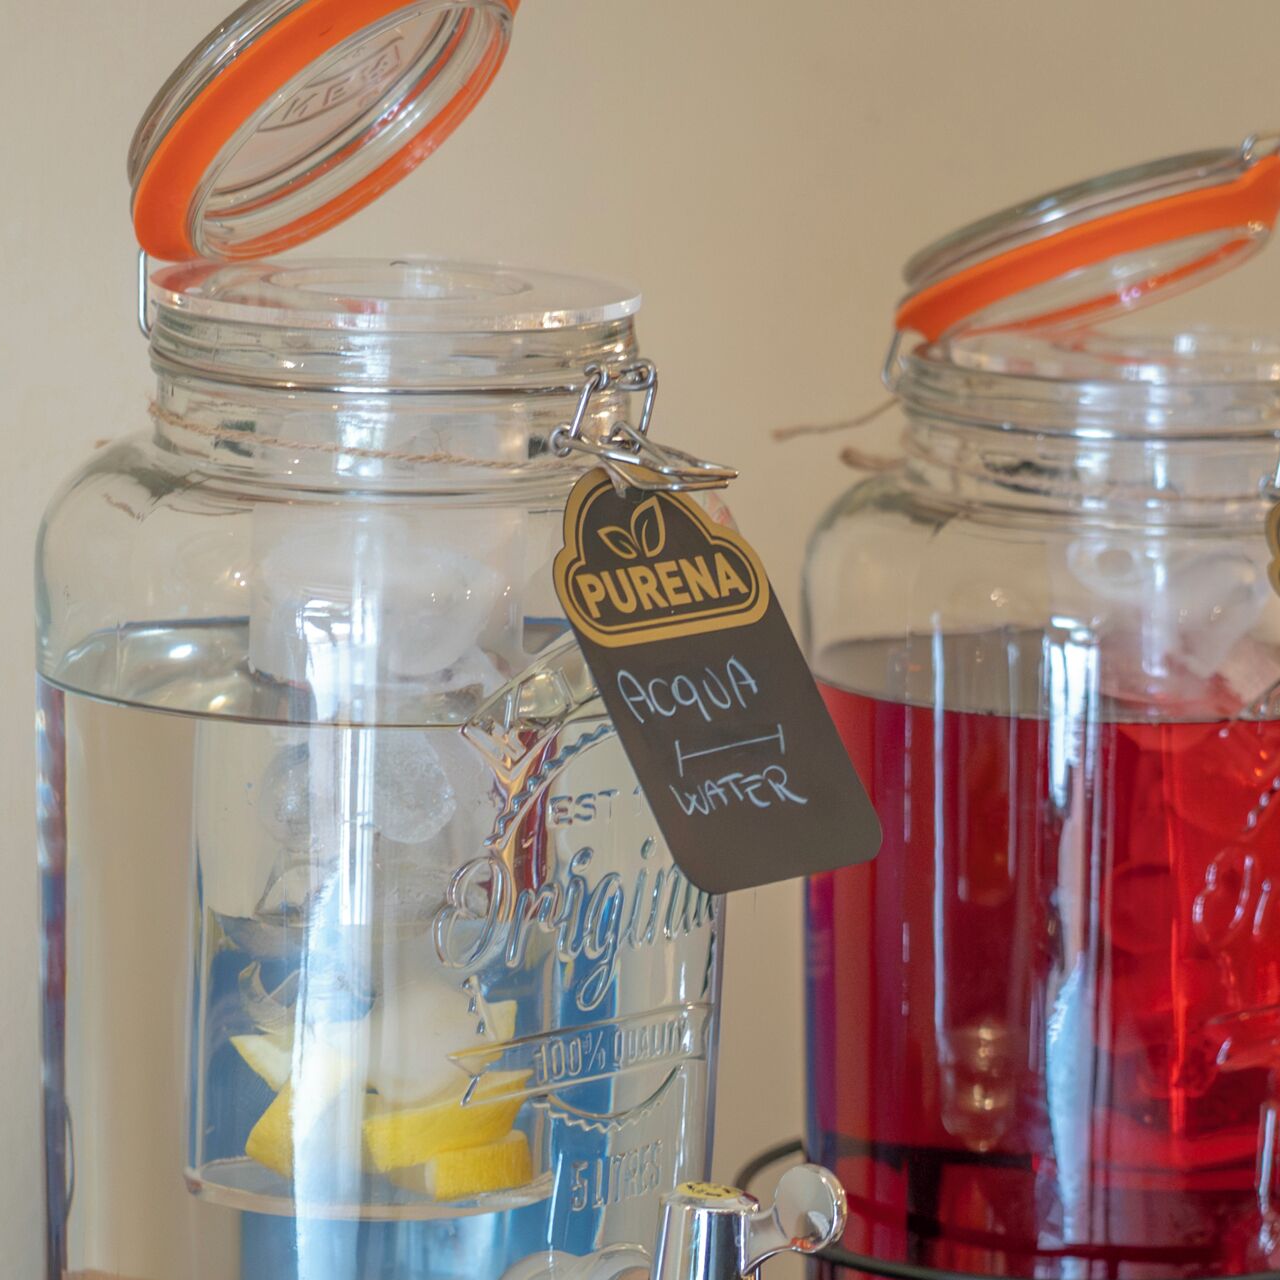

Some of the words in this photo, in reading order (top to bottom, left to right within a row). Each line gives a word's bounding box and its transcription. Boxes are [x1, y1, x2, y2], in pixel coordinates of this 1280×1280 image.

[575, 552, 749, 619] PURENA
[617, 655, 759, 724] ACQUA
[669, 764, 808, 817] WATER
[533, 1030, 606, 1086] 100%
